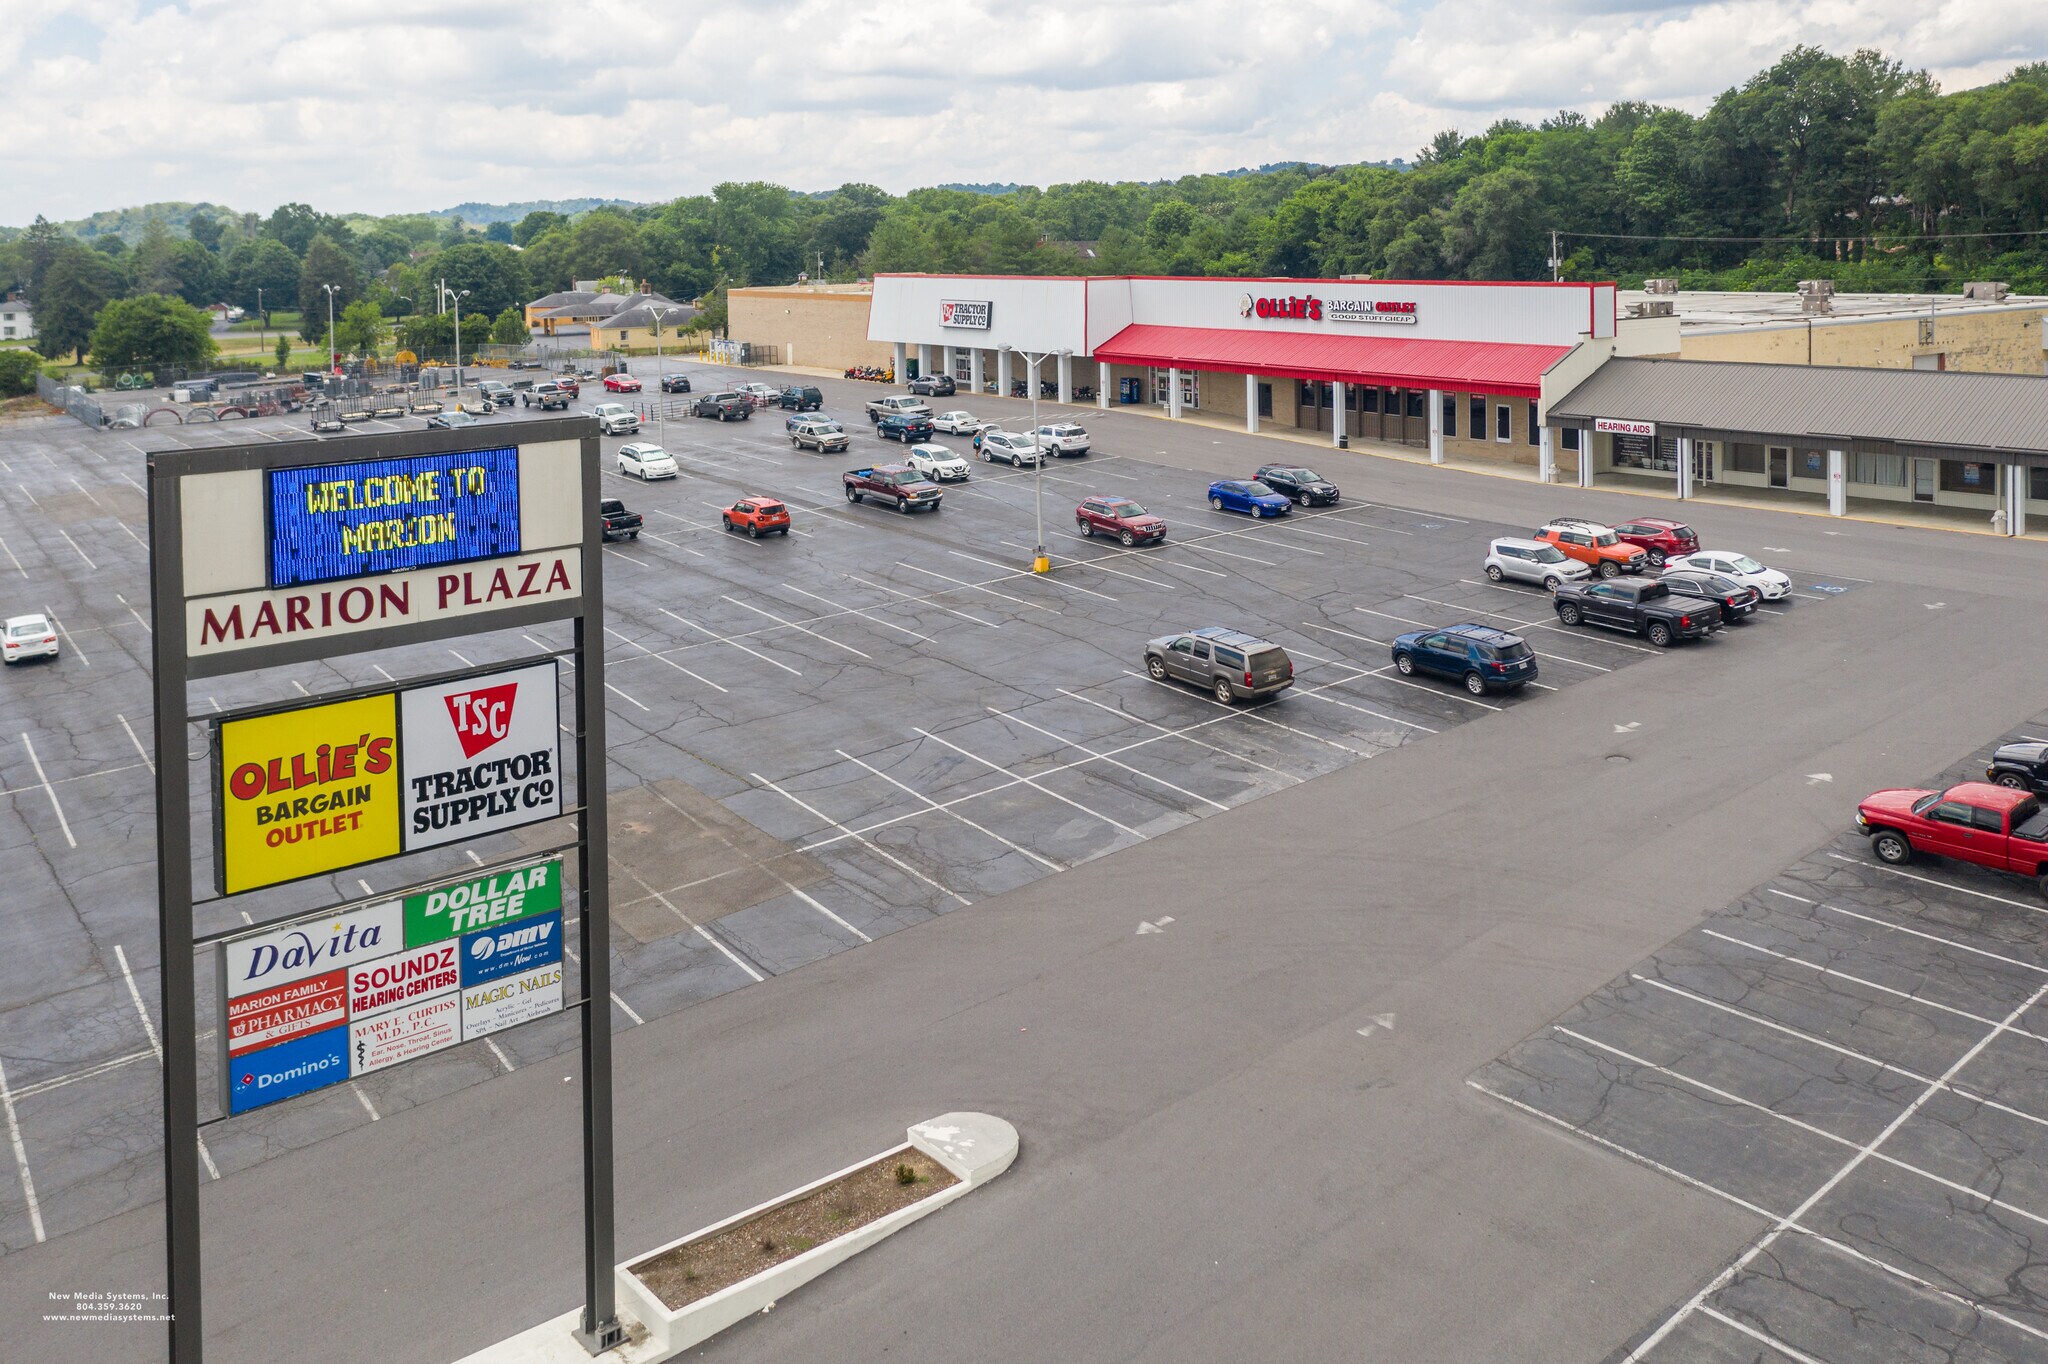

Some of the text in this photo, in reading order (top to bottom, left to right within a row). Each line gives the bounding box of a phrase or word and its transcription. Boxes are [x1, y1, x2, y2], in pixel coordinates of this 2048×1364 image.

[953, 314, 977, 325] SUPPLY
[954, 303, 986, 315] TRACTOR
[1256, 295, 1416, 320] OLLiE'S BARGAIN OUTLET
[1597, 421, 1650, 434] HEARING AIDS
[306, 466, 485, 515] WELCOME TO
[342, 512, 455, 556] MARION
[201, 559, 571, 645] MARION PLAZA
[453, 694, 507, 739] TSC
[230, 733, 393, 801] OLLiE'S
[412, 749, 552, 803] TRACTOR
[257, 784, 371, 826] BARGAIN
[413, 786, 520, 835] SUPPLY
[266, 810, 363, 848] OUTLET
[425, 866, 548, 917] DOLLAR
[449, 893, 526, 932] TREE
[243, 922, 382, 981] DaVita
[354, 947, 455, 994] SOUNDZ
[229, 980, 328, 1016] MARION FAMILY
[352, 969, 457, 1013] HEARING CENTERS
[466, 969, 561, 1011] MAGIC NAILS
[495, 1003, 515, 1013] Acrylic
[522, 997, 532, 1006] Gel
[248, 994, 344, 1033] PHARMACY
[265, 1019, 311, 1039] & GIFTS
[355, 1000, 456, 1038] MARY E. CURTISS
[413, 1018, 435, 1031] P.C.
[433, 1027, 452, 1038] Sinus
[466, 1018, 491, 1030] Overlays
[498, 1008, 527, 1020] Manicures
[534, 997, 560, 1009] Pedicures
[494, 1020, 507, 1029] Nail
[526, 1007, 551, 1018] Airbrush
[403, 1043, 430, 1056] Hearing
[431, 1036, 453, 1047] Center
[258, 1053, 340, 1089] Domino's
